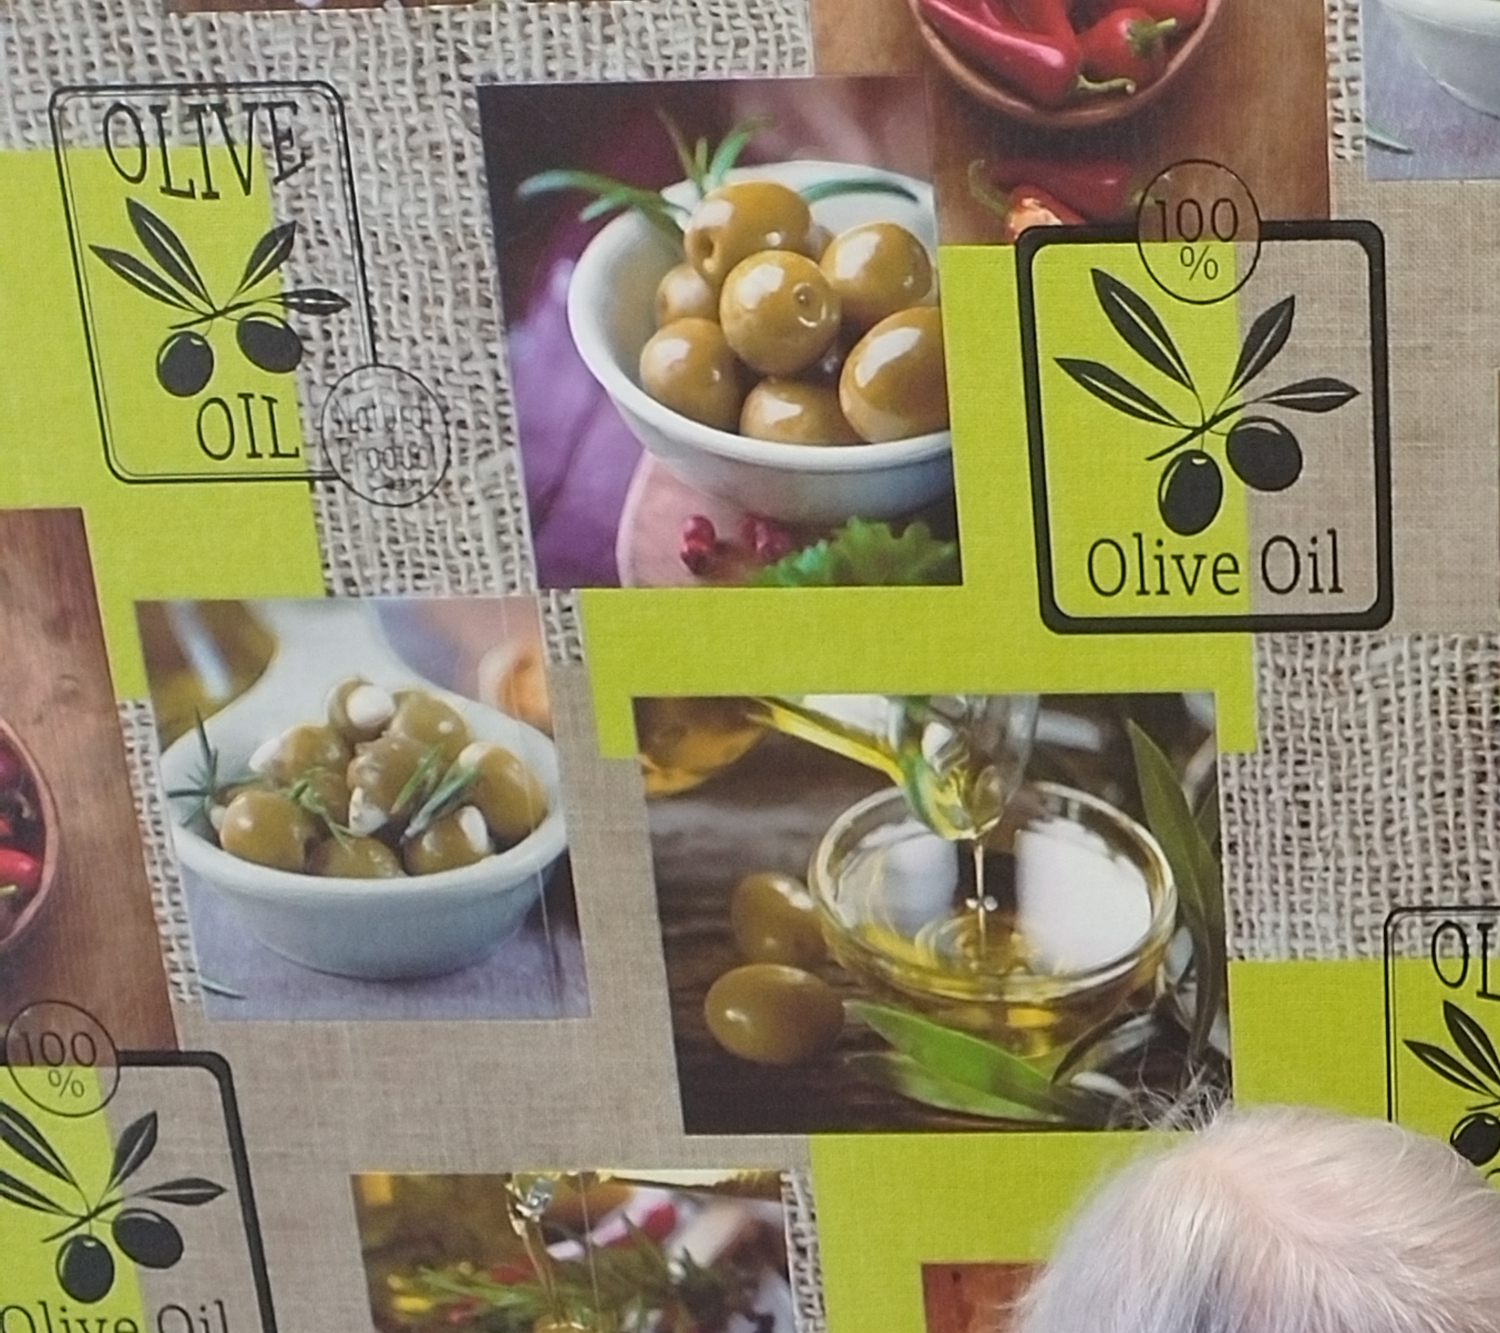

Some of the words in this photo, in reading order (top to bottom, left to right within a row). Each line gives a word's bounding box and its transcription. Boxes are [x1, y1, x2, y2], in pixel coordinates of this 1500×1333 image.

[100, 100, 308, 201] OLIVE
[1154, 197, 1239, 244] 100
[1180, 245, 1219, 280] %
[196, 392, 300, 460] OIL
[1087, 533, 1241, 597] Olive
[1260, 530, 1343, 595] Oil
[19, 1031, 97, 1067] 100
[47, 1069, 85, 1099] %
